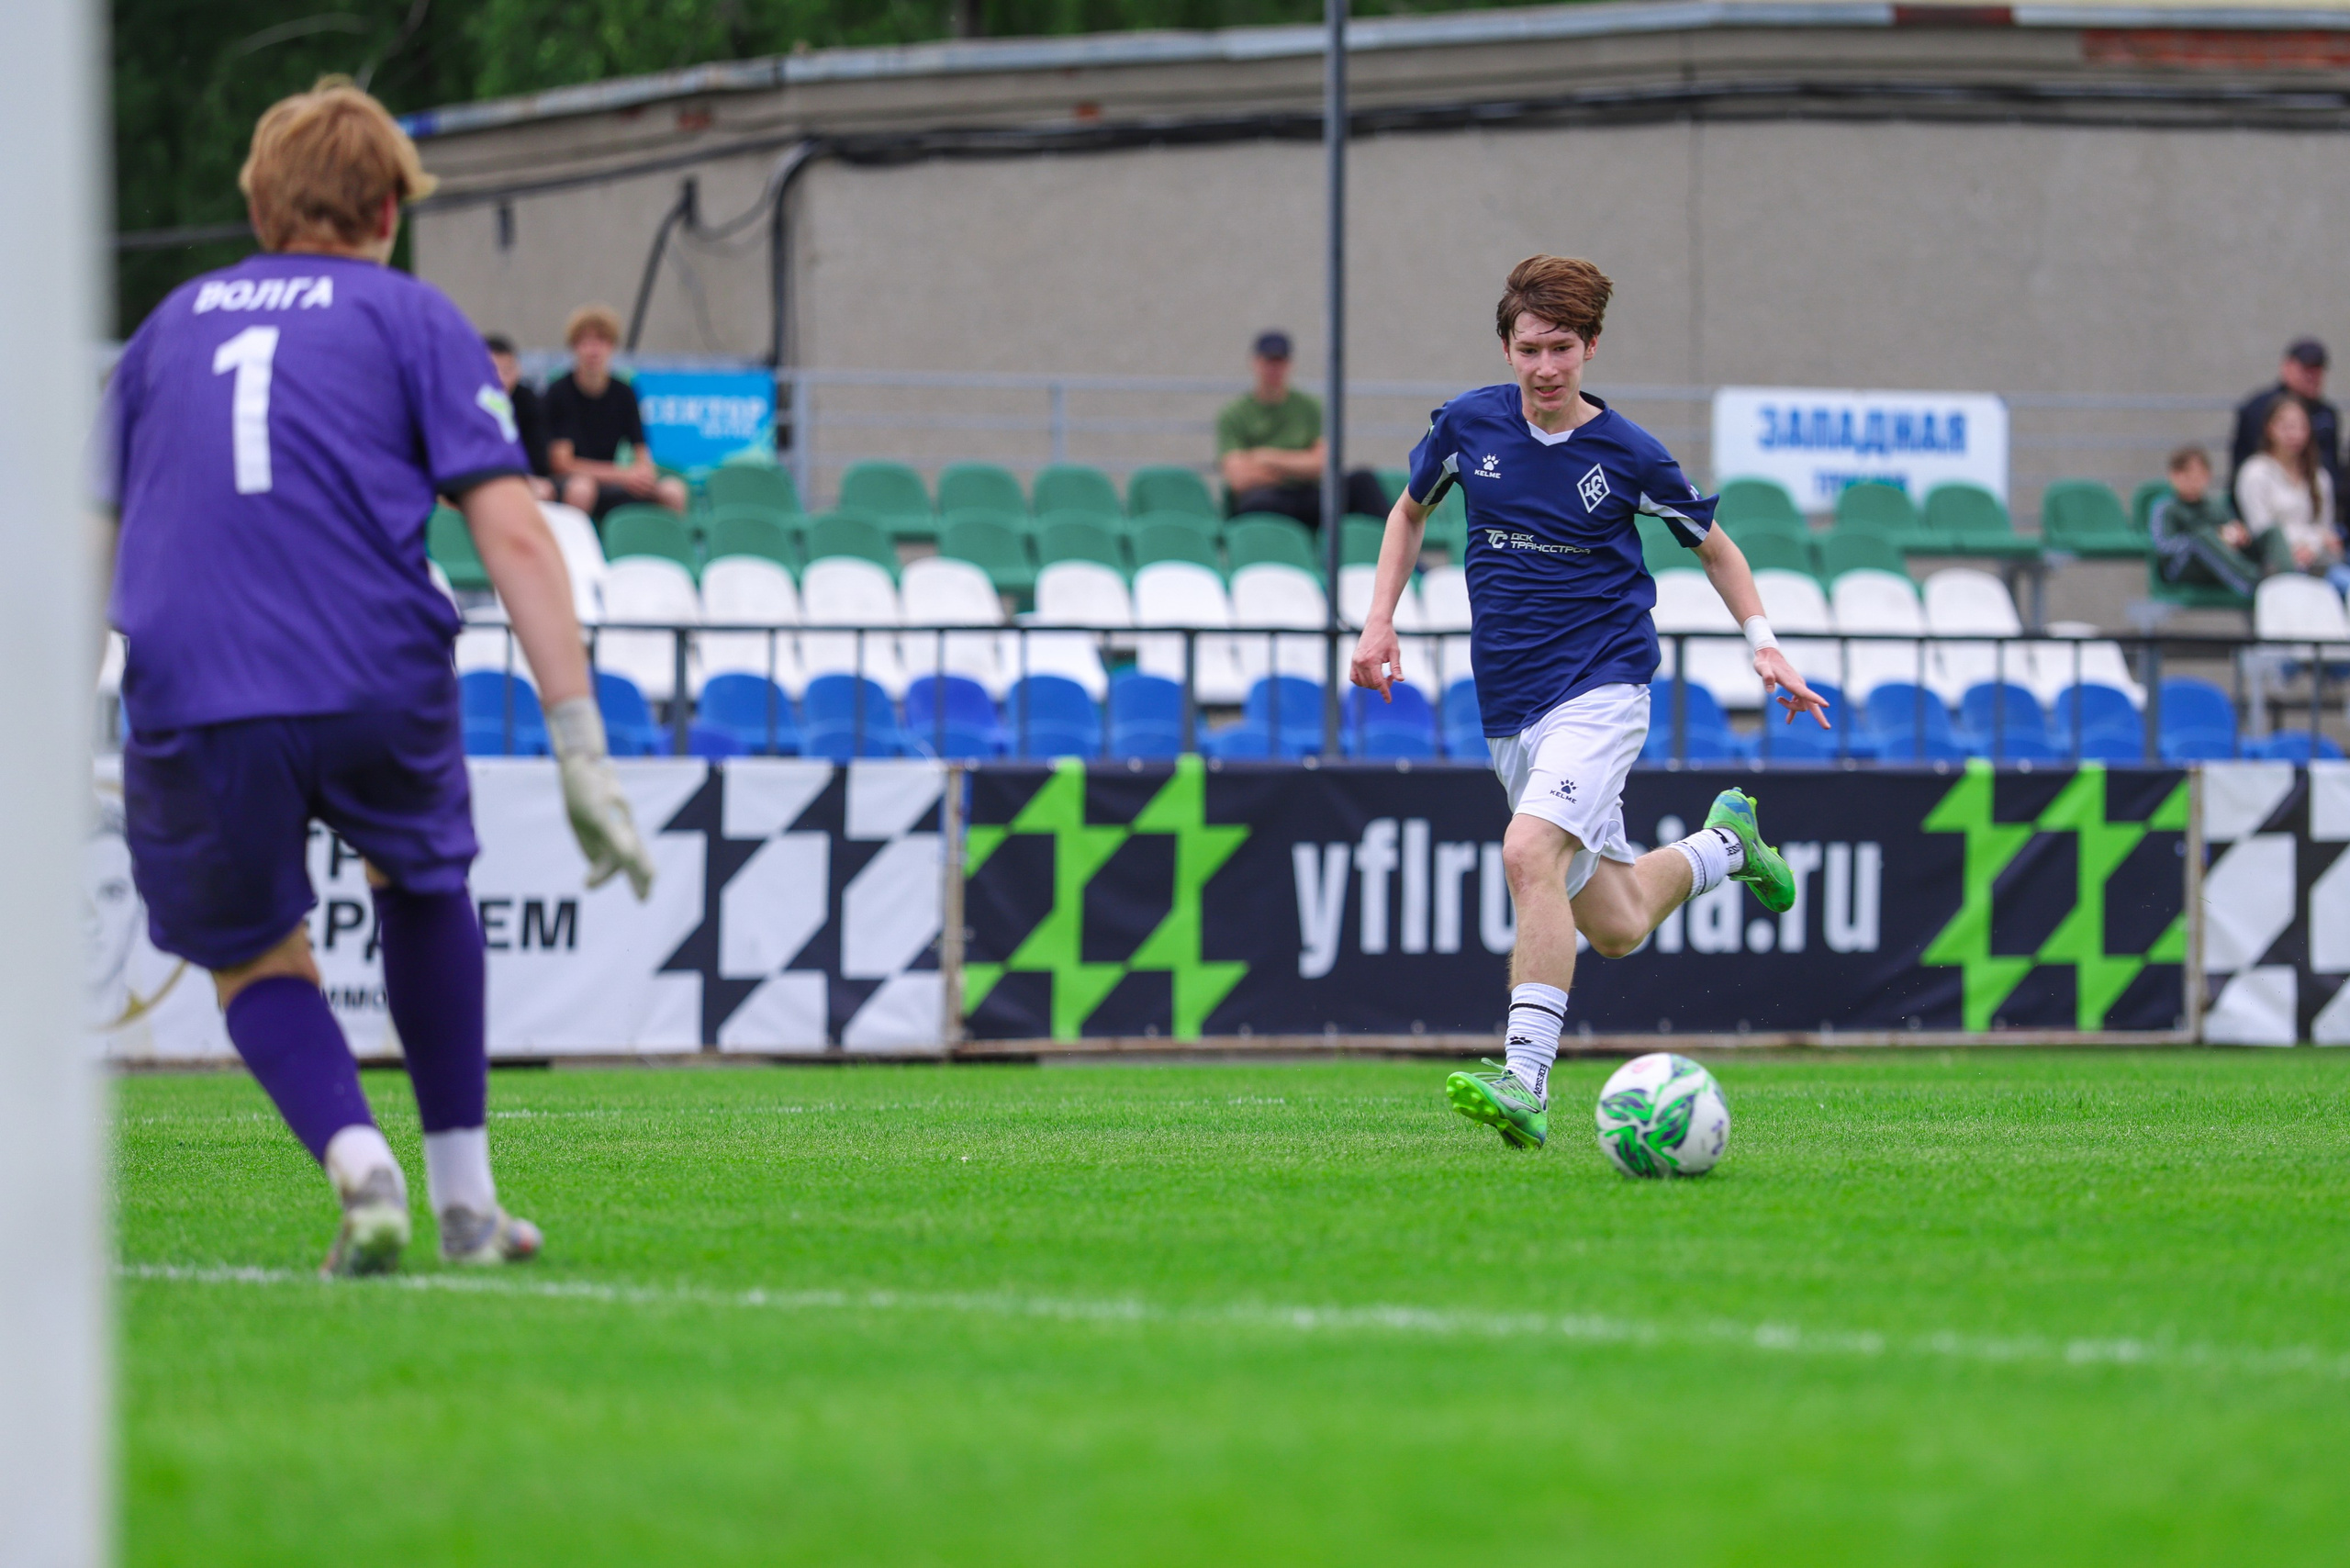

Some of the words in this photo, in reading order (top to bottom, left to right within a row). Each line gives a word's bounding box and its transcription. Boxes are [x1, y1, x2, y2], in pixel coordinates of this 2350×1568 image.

[193, 275, 333, 315] ВОЛГА
[212, 323, 280, 496] 1
[1758, 408, 1967, 457] ЗАПАДНАЯ
[1474, 469, 1501, 479] KELME
[1550, 790, 1577, 804] KELME
[1291, 817, 1881, 980] yflruia.ru
